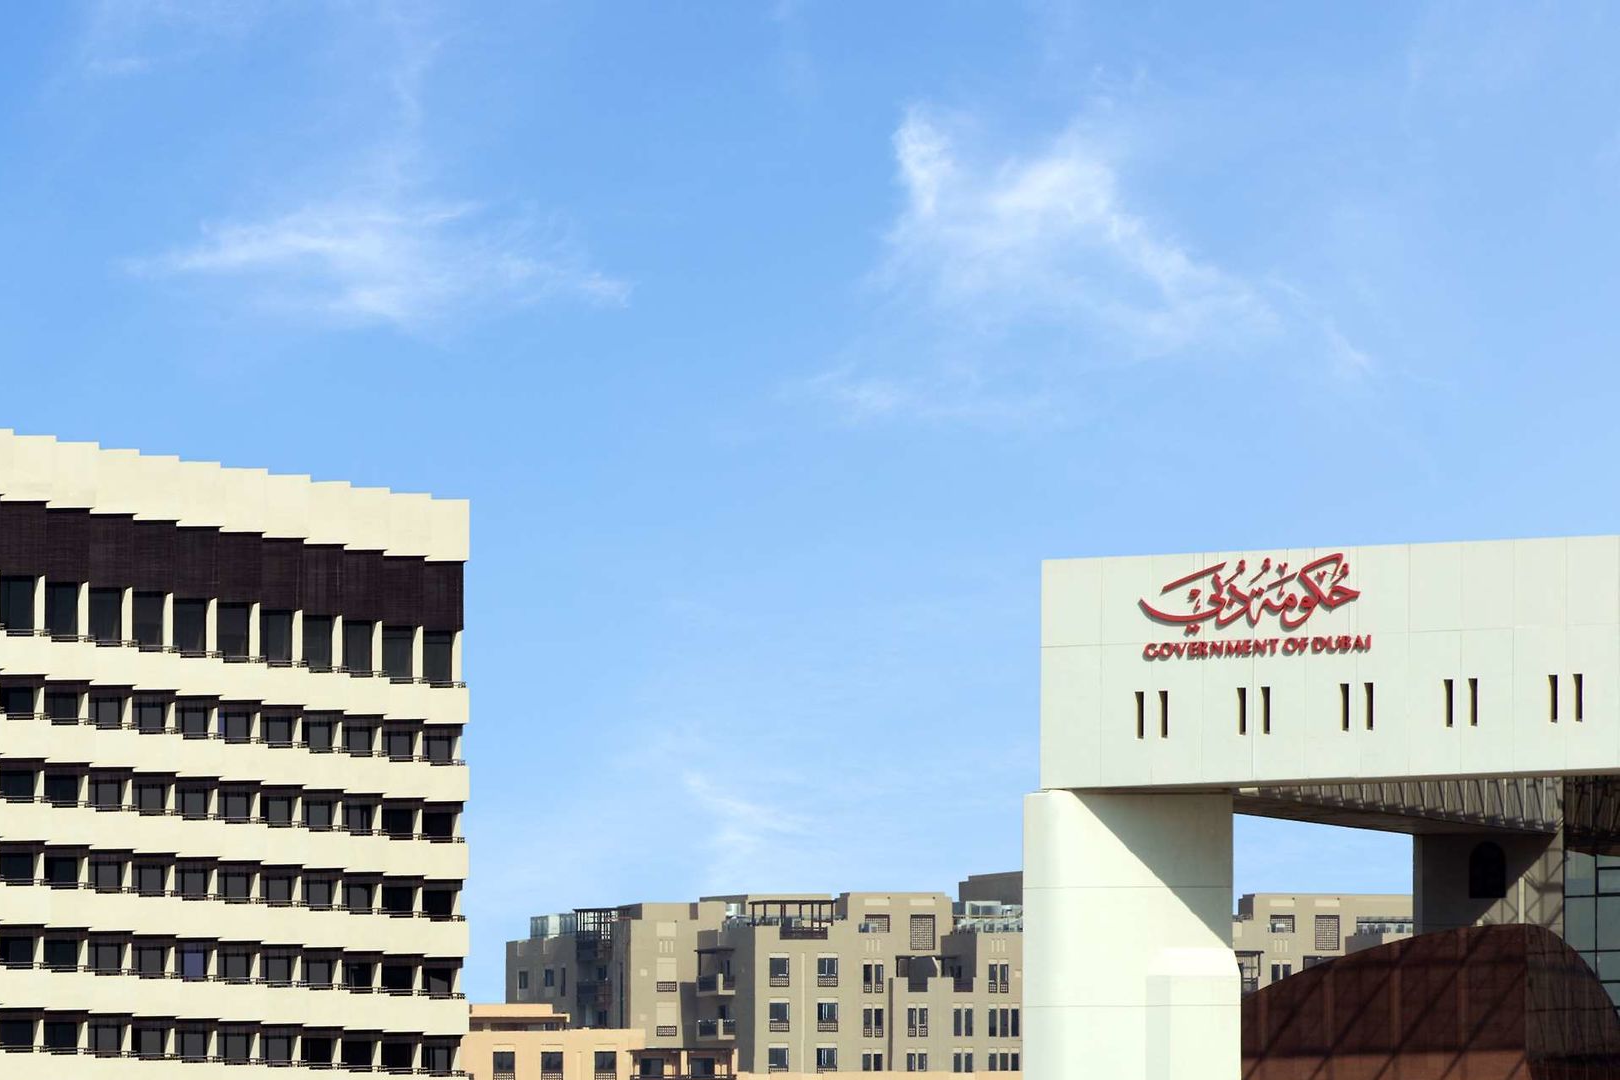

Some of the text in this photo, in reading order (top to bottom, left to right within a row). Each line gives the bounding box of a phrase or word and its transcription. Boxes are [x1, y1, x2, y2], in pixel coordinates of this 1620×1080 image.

[1144, 634, 1372, 660] GOVERNMENT OF DUBAI
